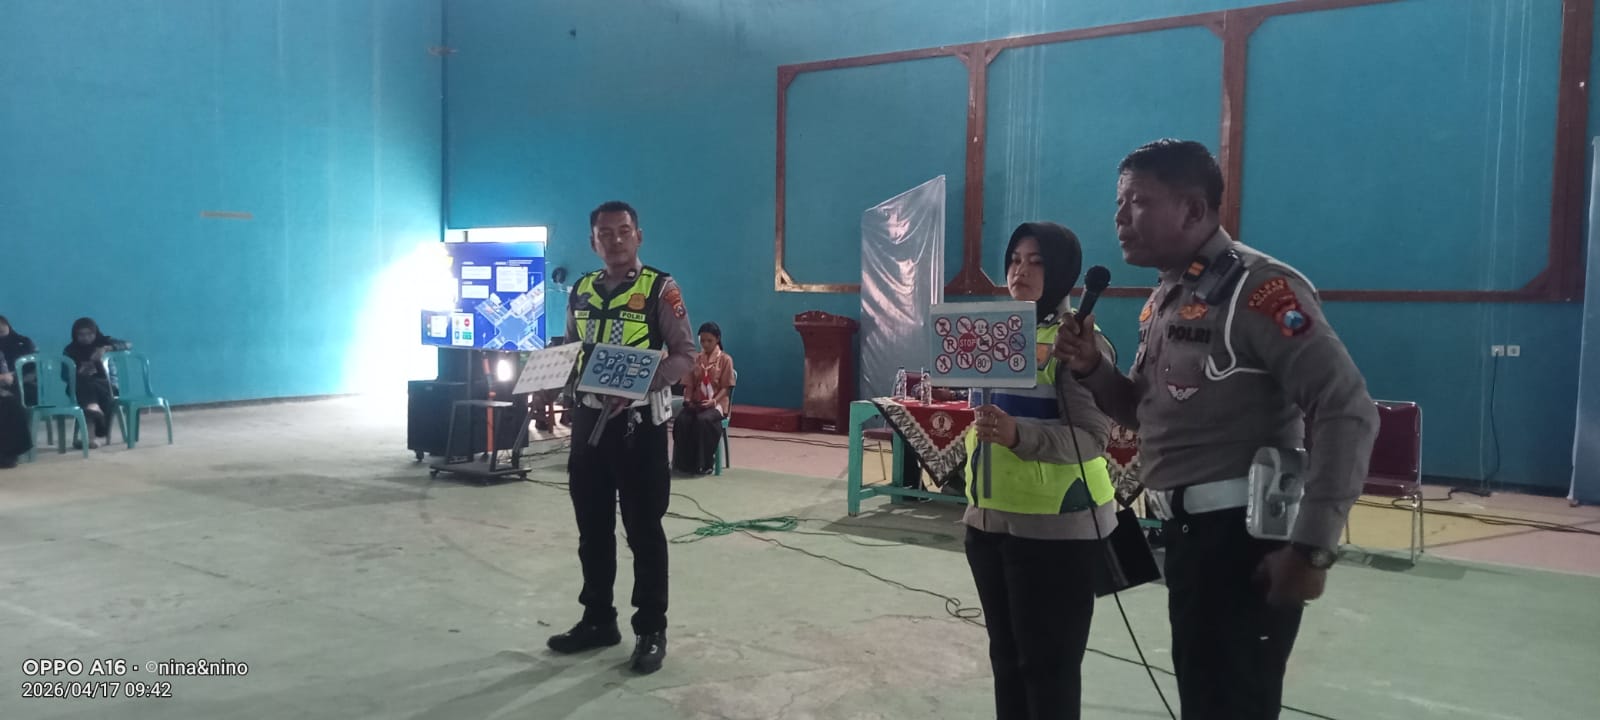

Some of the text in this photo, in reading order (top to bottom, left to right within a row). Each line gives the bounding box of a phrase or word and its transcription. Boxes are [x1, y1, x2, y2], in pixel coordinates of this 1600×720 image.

[622, 312, 644, 321] POLRI
[1168, 325, 1210, 343] POLRI
[959, 338, 976, 348] STOP
[606, 358, 615, 367] P
